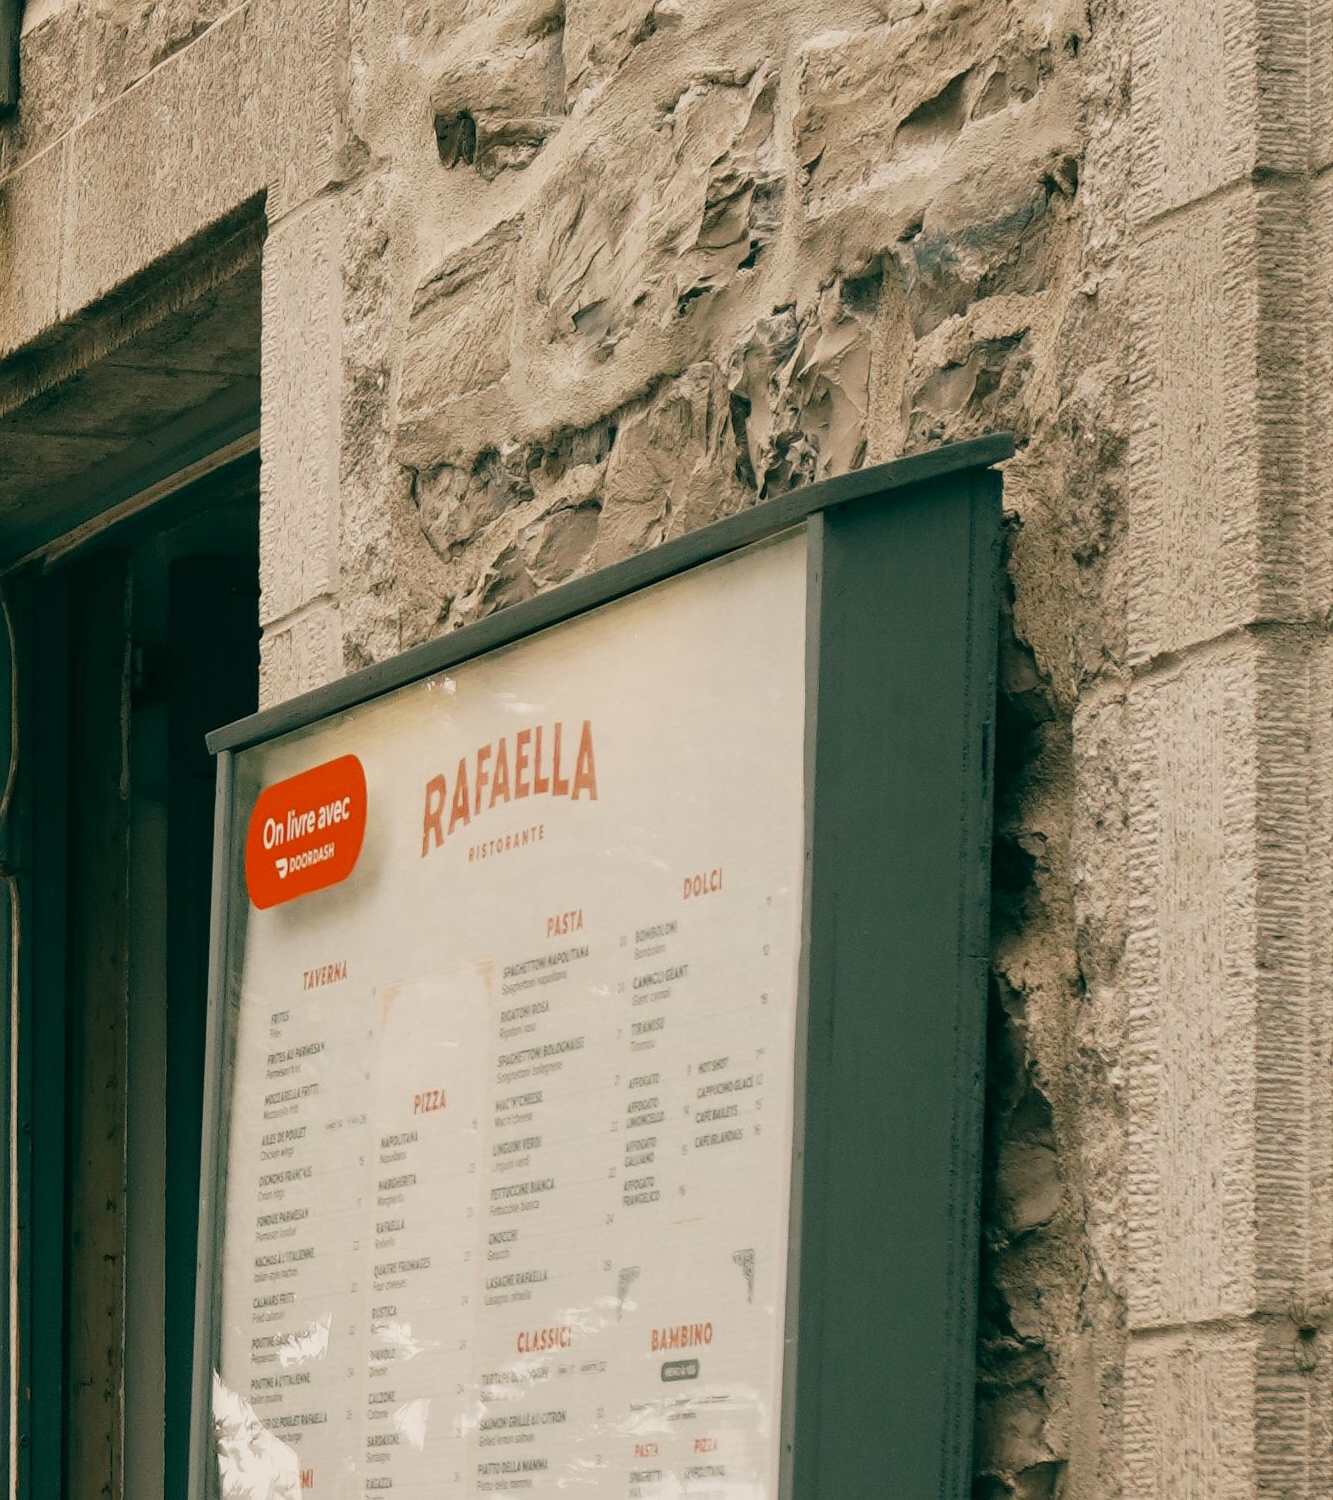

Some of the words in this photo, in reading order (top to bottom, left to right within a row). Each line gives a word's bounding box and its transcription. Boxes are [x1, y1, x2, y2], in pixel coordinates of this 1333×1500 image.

[420, 720, 598, 858] RAFAELLA
[263, 818, 284, 850] On
[286, 809, 315, 843] livre
[317, 797, 350, 832] avec
[289, 842, 335, 873] DOORDASH
[468, 824, 545, 863] RISTORANTE
[683, 868, 723, 900] DOLCI
[547, 909, 583, 938] PASTA
[302, 961, 348, 990] TAVERNA
[413, 1089, 446, 1115] PIZZA
[650, 1322, 713, 1351] BAMBINO
